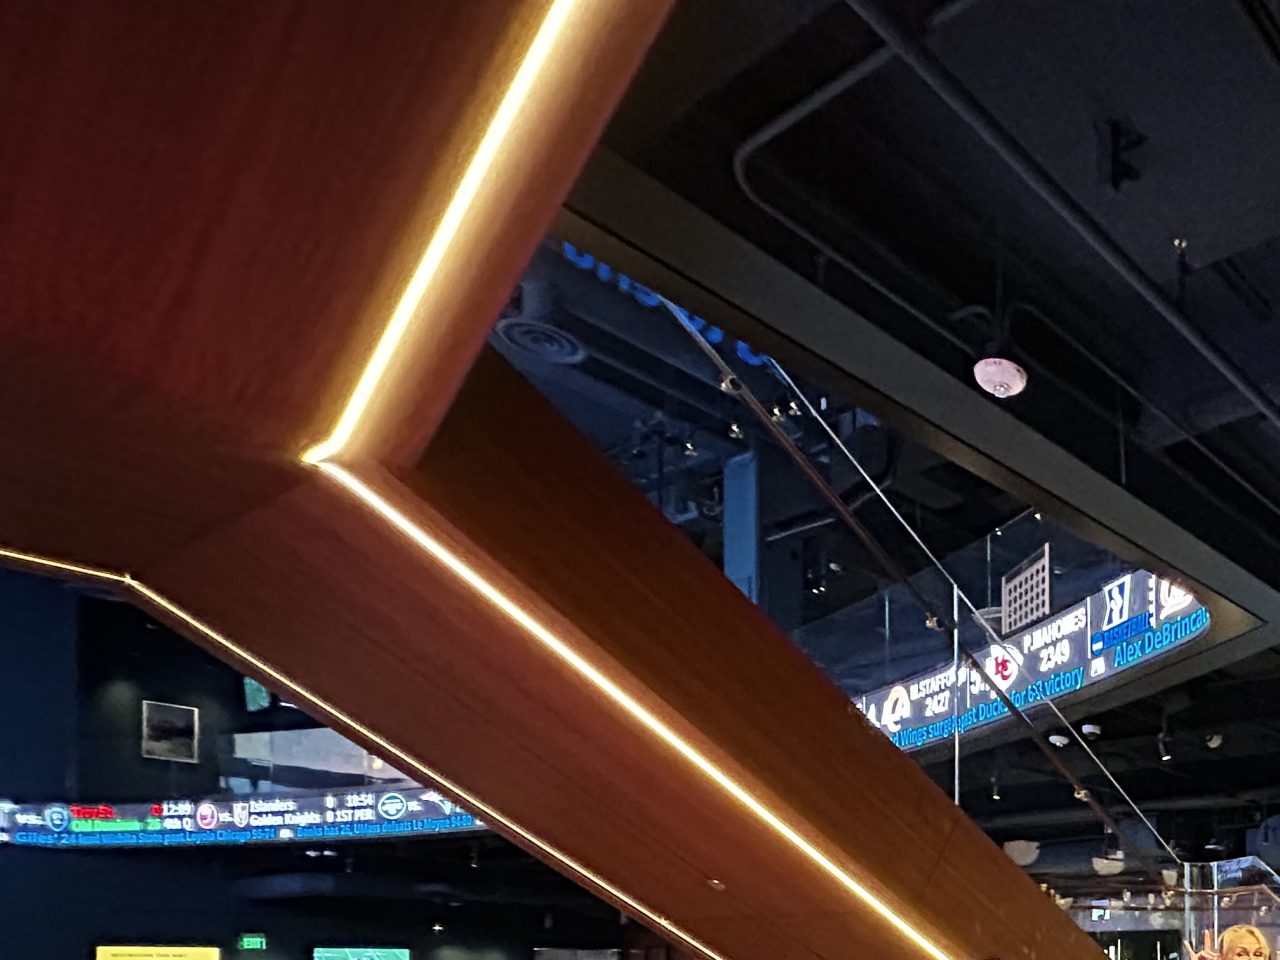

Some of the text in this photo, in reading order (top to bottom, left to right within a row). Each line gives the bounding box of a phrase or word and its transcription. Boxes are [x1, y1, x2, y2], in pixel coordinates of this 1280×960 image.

[1040, 639, 1069, 672] 2349
[1114, 640, 1142, 668] Alex
[901, 727, 927, 747] Wings
[1045, 666, 1084, 696] victory
